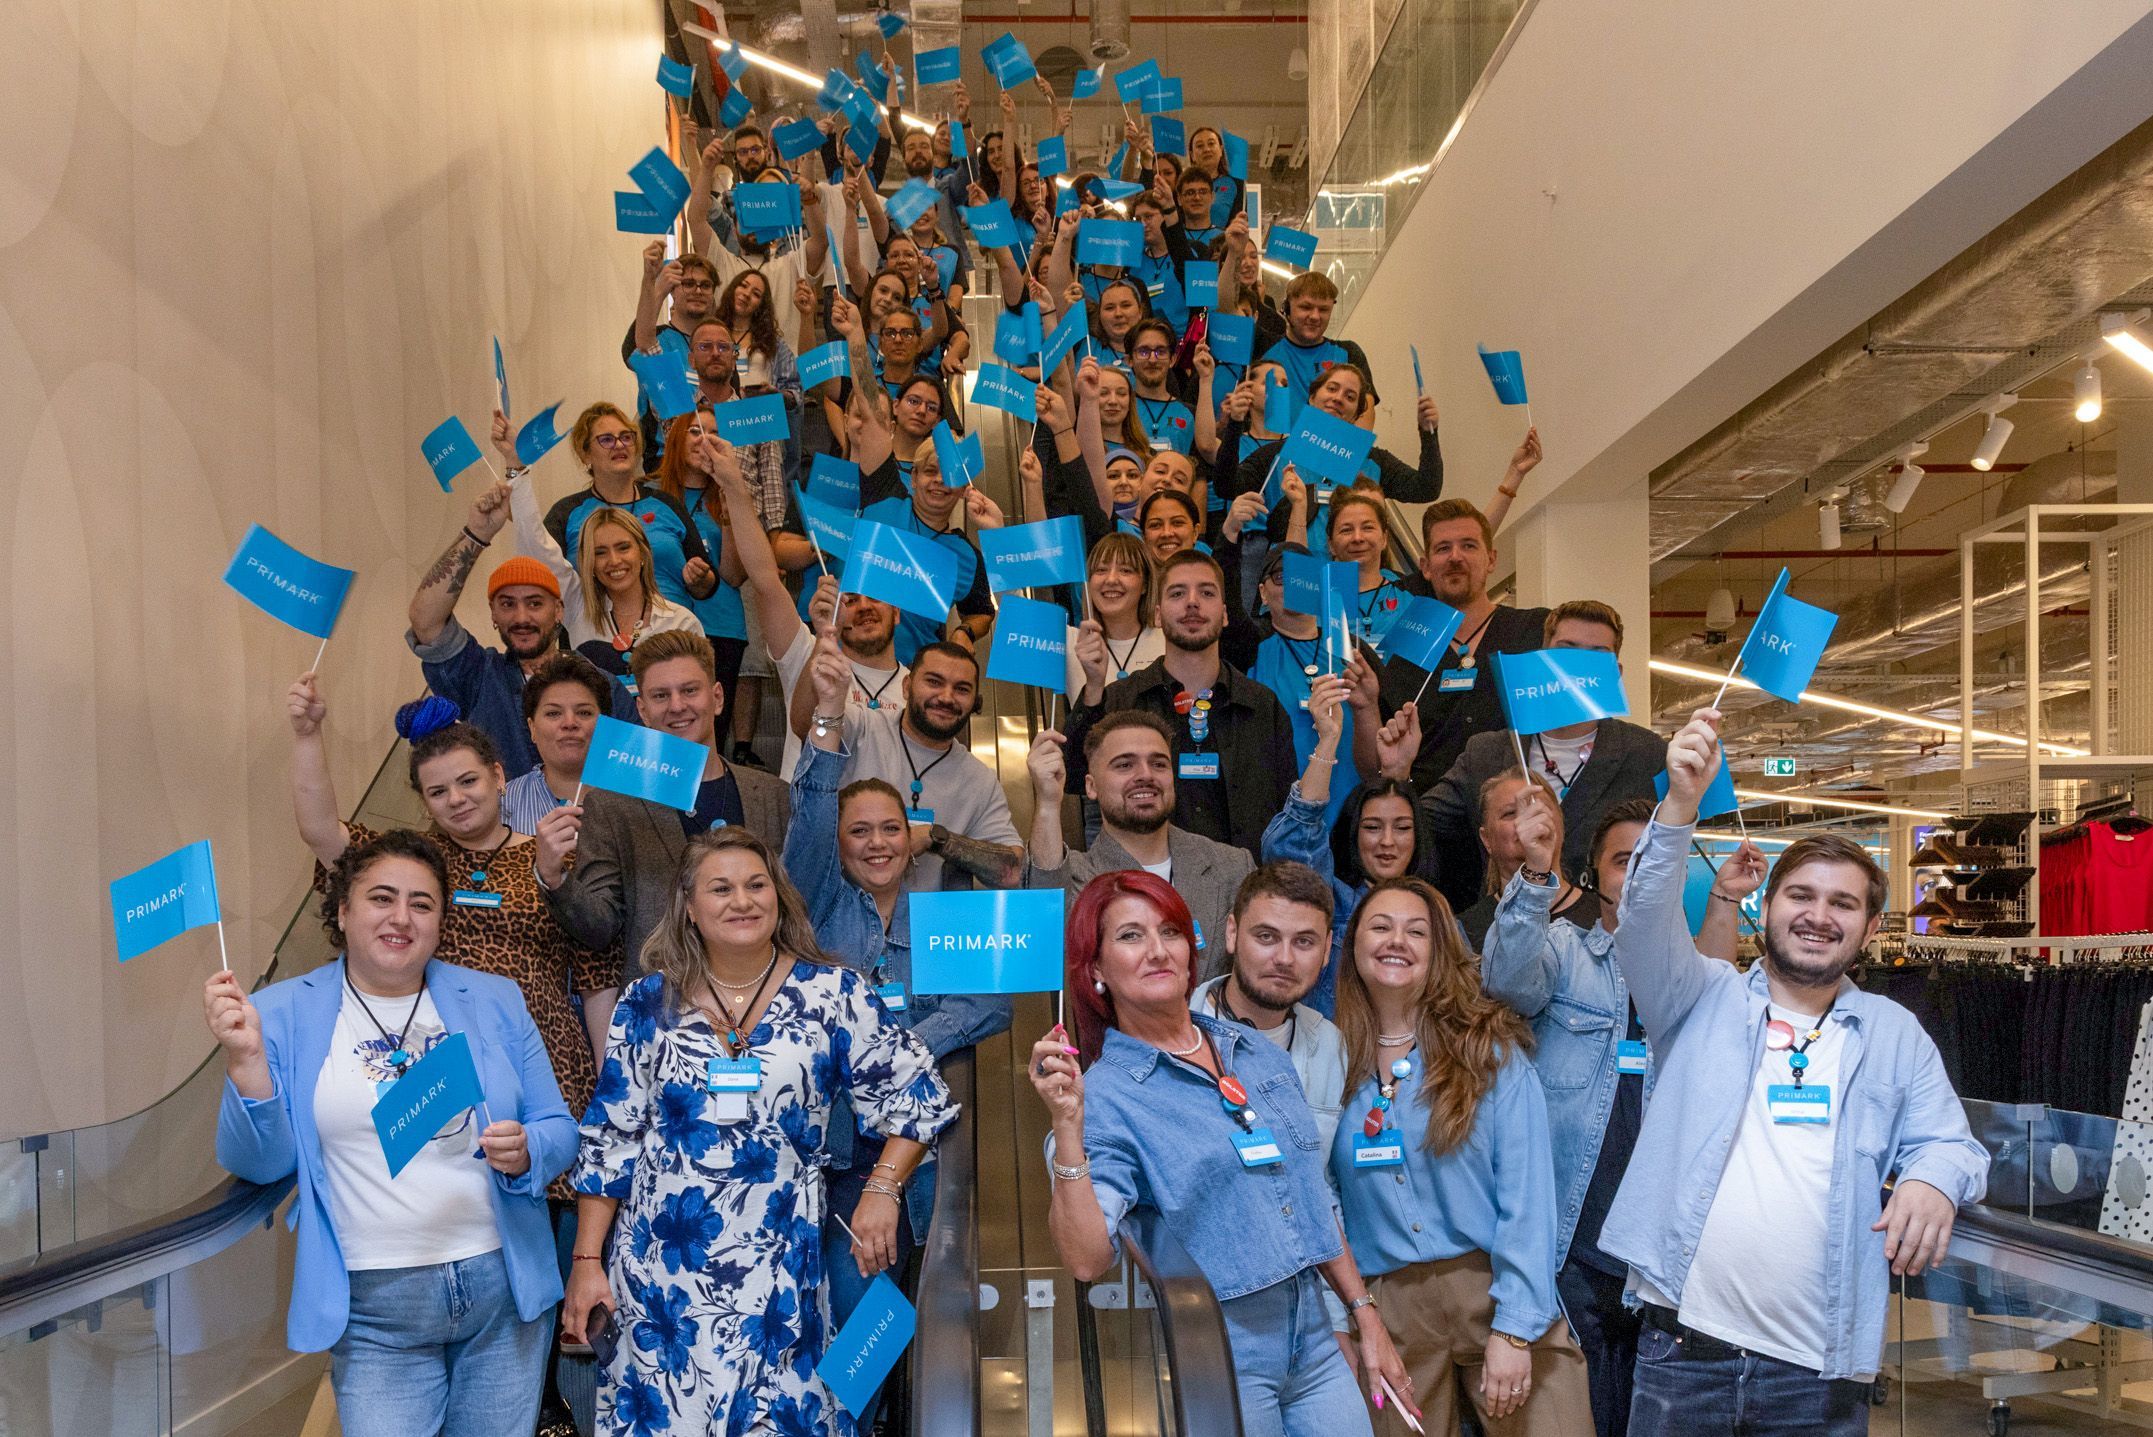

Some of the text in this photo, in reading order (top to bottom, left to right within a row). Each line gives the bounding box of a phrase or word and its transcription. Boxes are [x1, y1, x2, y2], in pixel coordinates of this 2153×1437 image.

[742, 201, 778, 209] PRIMARK
[1274, 239, 1306, 253] PRIMARK
[1192, 279, 1218, 287] PRIM
[805, 355, 846, 373] PRIMARK
[982, 380, 1025, 402] PRIMARK
[728, 414, 774, 428] PRIMARK
[1301, 430, 1353, 460] PRIMARK
[995, 546, 1063, 565] PRIMARK
[861, 551, 935, 585] PRIMARK
[246, 556, 321, 605] PRIMARK
[1290, 577, 1320, 593] PRIMA
[1515, 677, 1600, 700] PRIMARK
[608, 748, 680, 778] PRIMARK
[126, 883, 185, 924] PRIMARK
[929, 934, 1029, 951] PRIMARK
[1777, 1092, 1821, 1100] PRIMARK
[389, 1078, 447, 1141] PRIMARK
[1361, 1151, 1383, 1159] Catalina
[846, 1308, 895, 1379] PRIMARK
